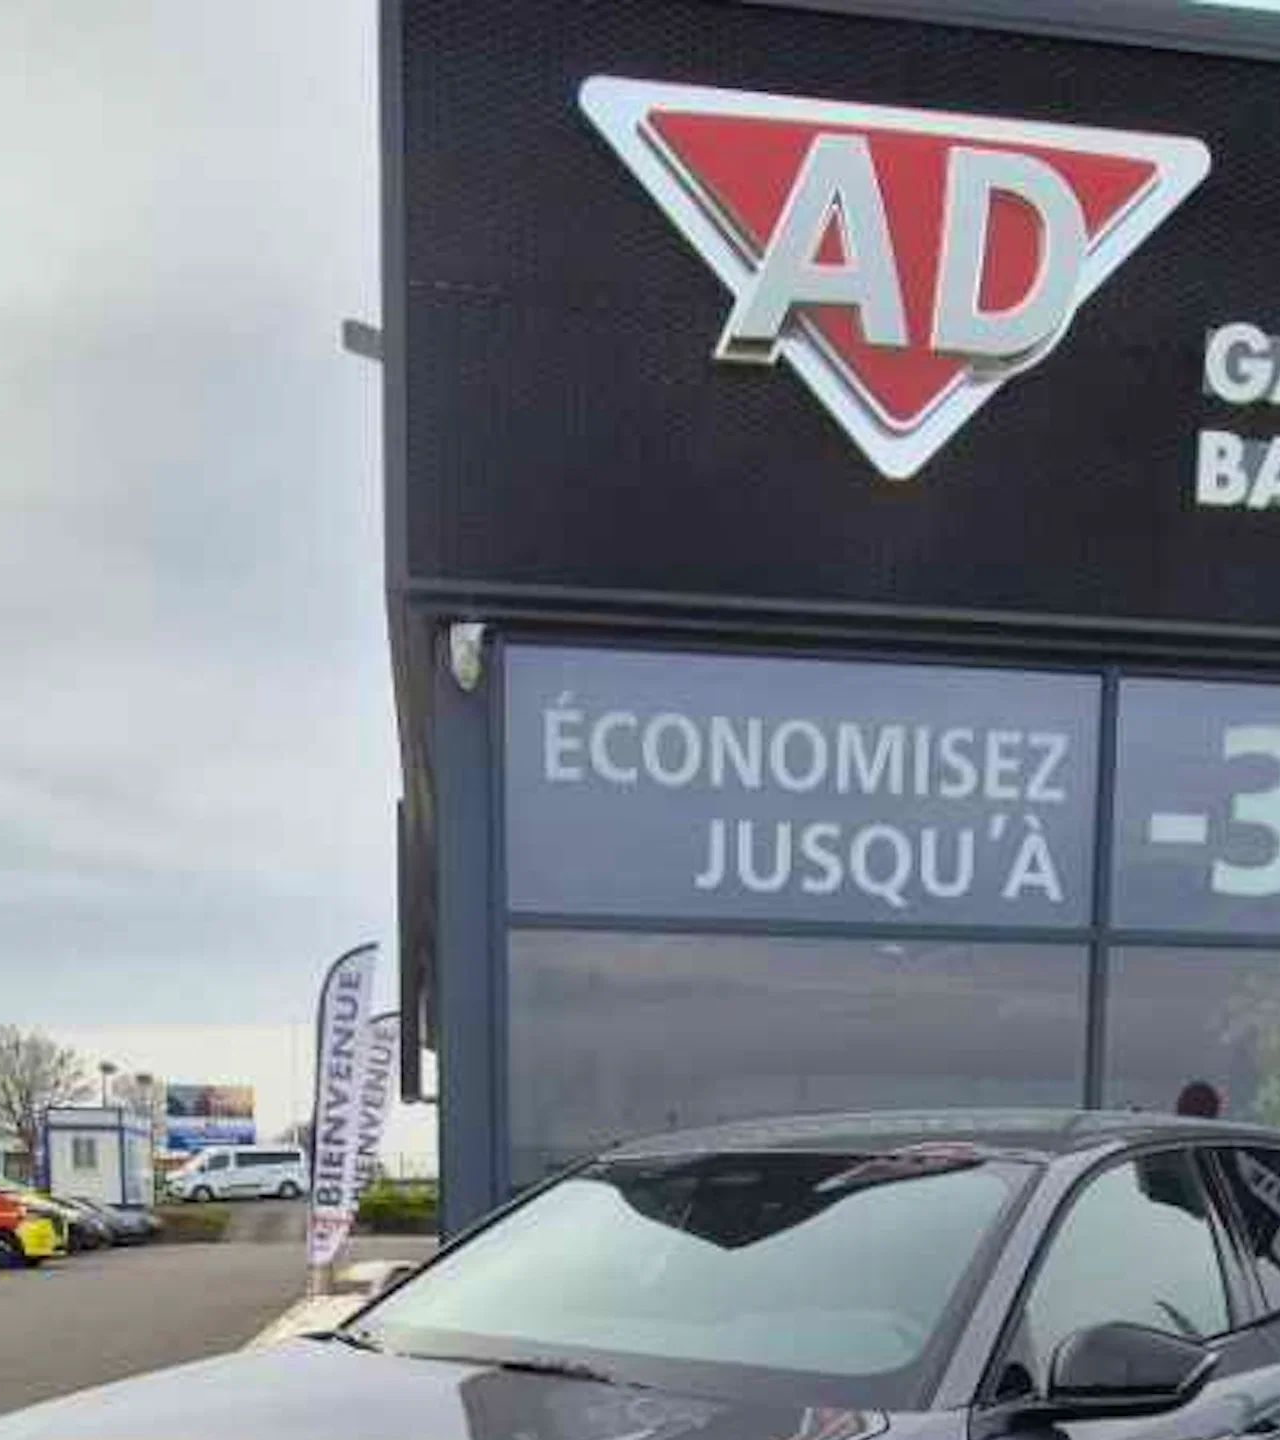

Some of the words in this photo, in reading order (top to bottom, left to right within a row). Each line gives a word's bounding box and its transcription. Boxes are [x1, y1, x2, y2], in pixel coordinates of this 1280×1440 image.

[715, 133, 1090, 362] AD
[542, 690, 1071, 801] ÉCONOMISEZ
[317, 969, 362, 1206] BIENVENUE
